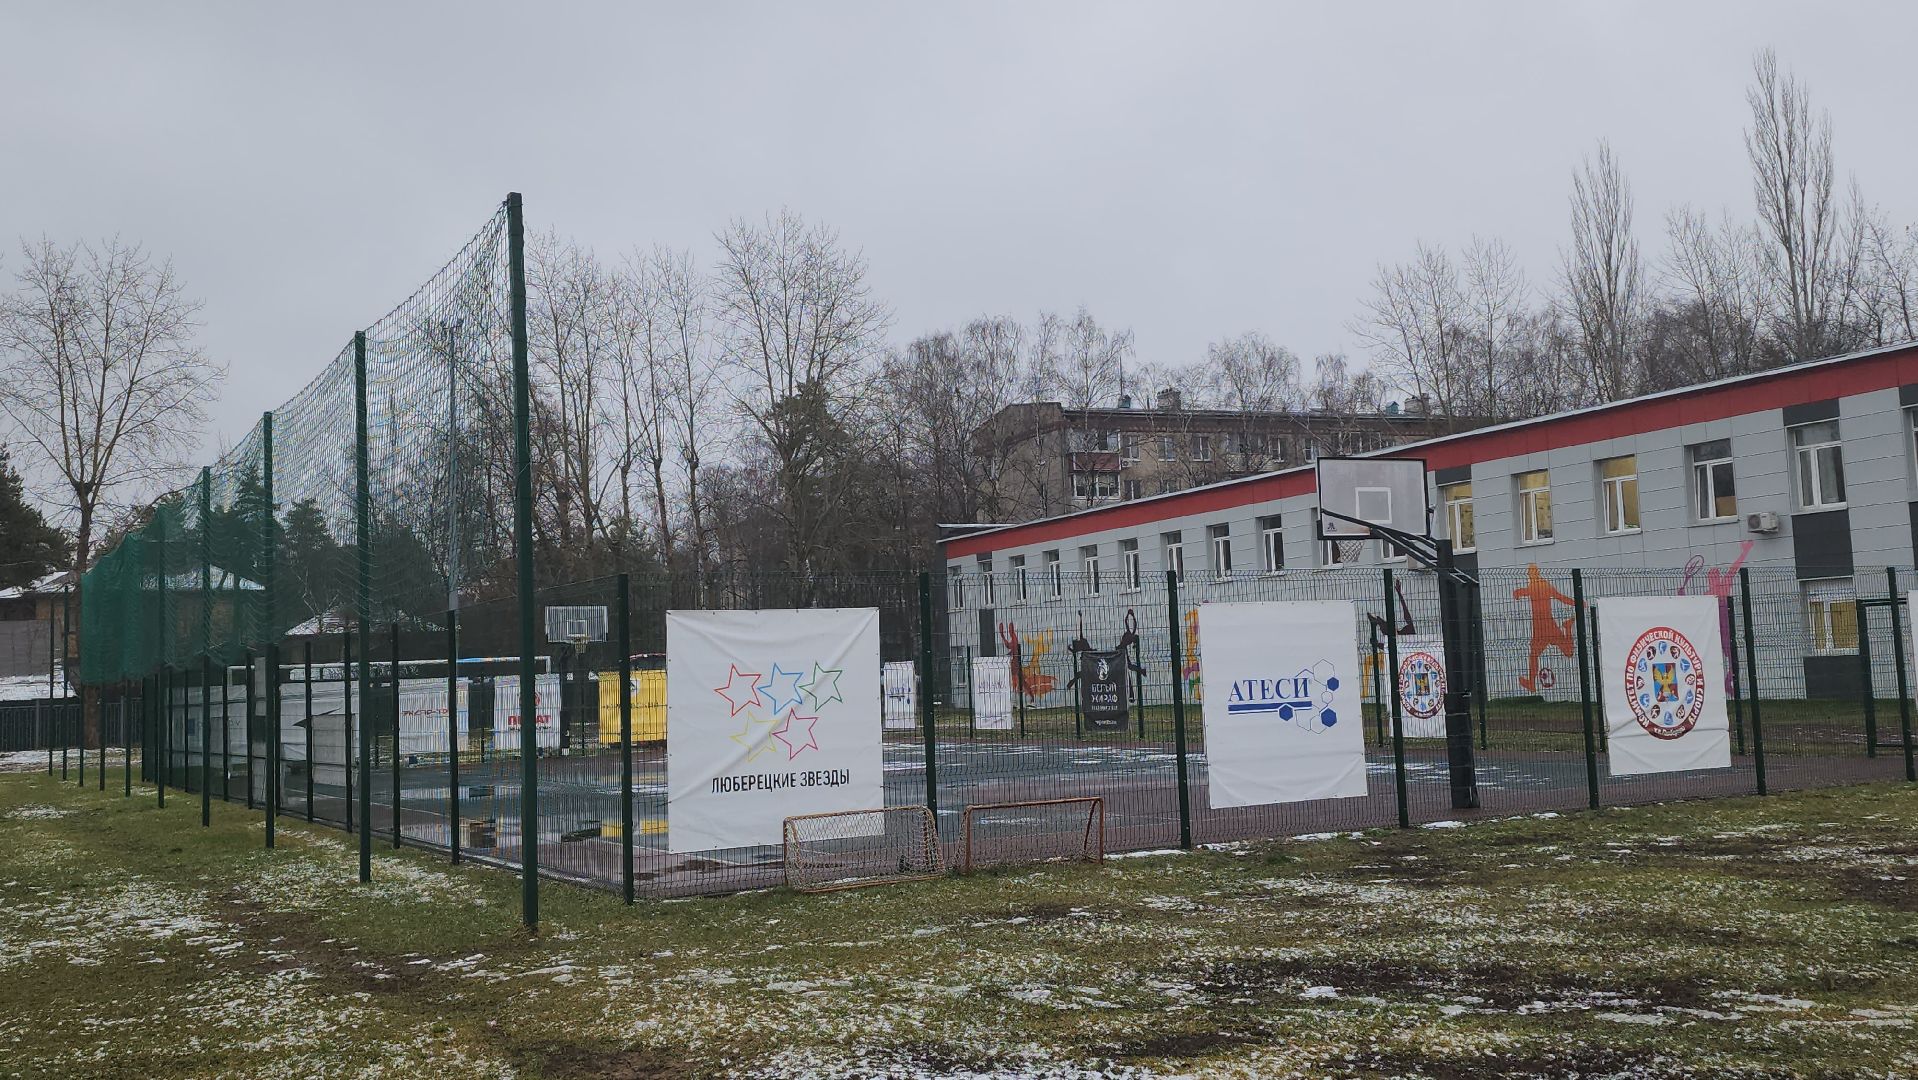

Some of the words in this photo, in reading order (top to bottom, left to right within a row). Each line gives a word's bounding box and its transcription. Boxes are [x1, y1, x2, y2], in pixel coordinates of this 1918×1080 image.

[1626, 666, 1634, 680] ПО
[1688, 688, 1704, 725] СПОРТУ
[711, 772, 797, 794] ЛЮБЕРЕЦКИЕ
[800, 768, 850, 788] ЗВЕЗДЫ
